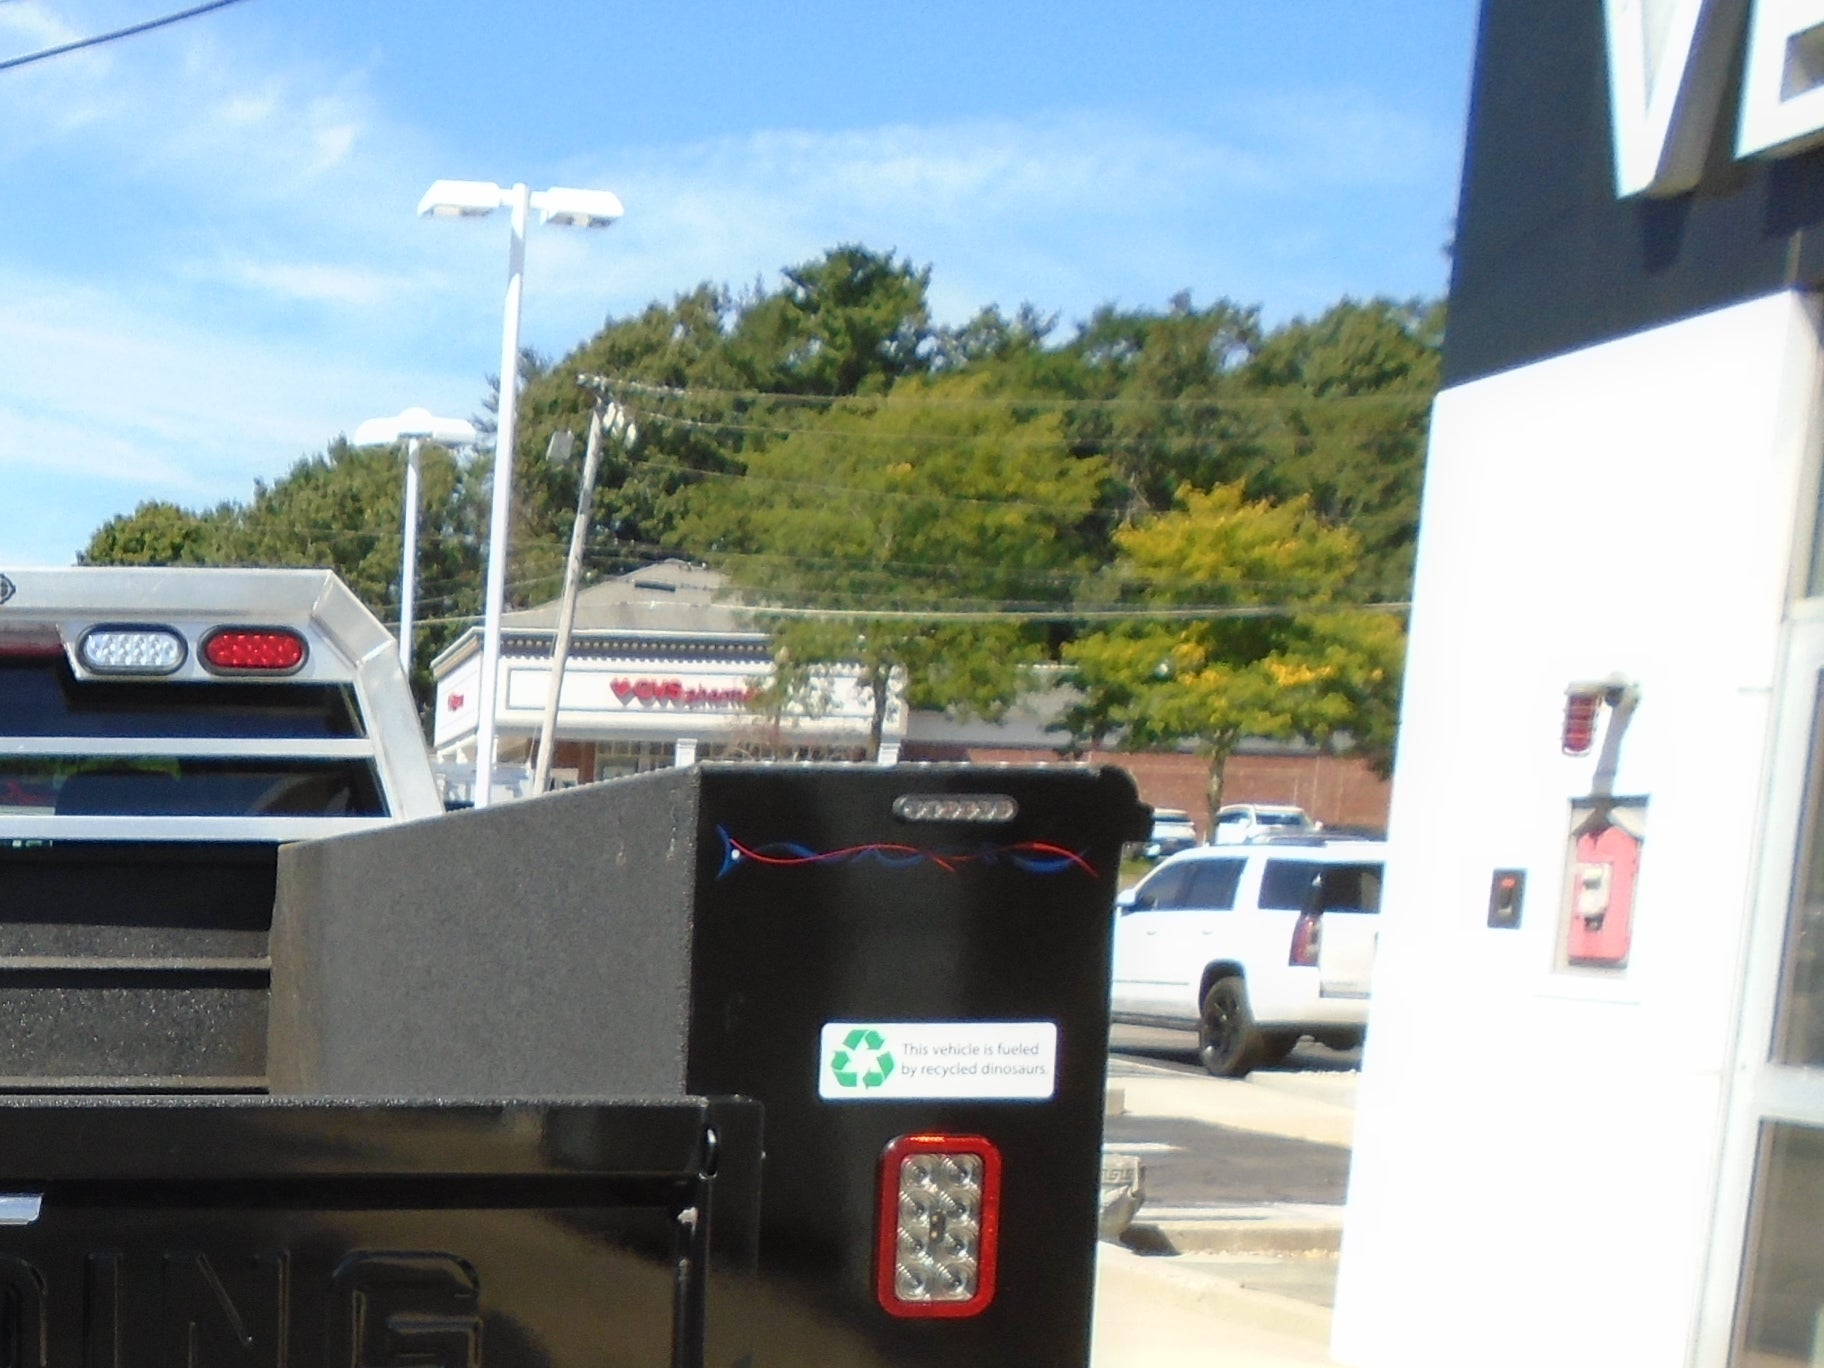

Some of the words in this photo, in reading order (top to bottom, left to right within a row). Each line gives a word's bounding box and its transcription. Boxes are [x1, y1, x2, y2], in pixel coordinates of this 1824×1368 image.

[903, 1043, 928, 1056] This
[933, 1043, 980, 1056] vehicle
[984, 1043, 993, 1056] is
[997, 1043, 1039, 1056] fueled
[901, 1063, 916, 1076] by
[921, 1063, 977, 1076] recycled
